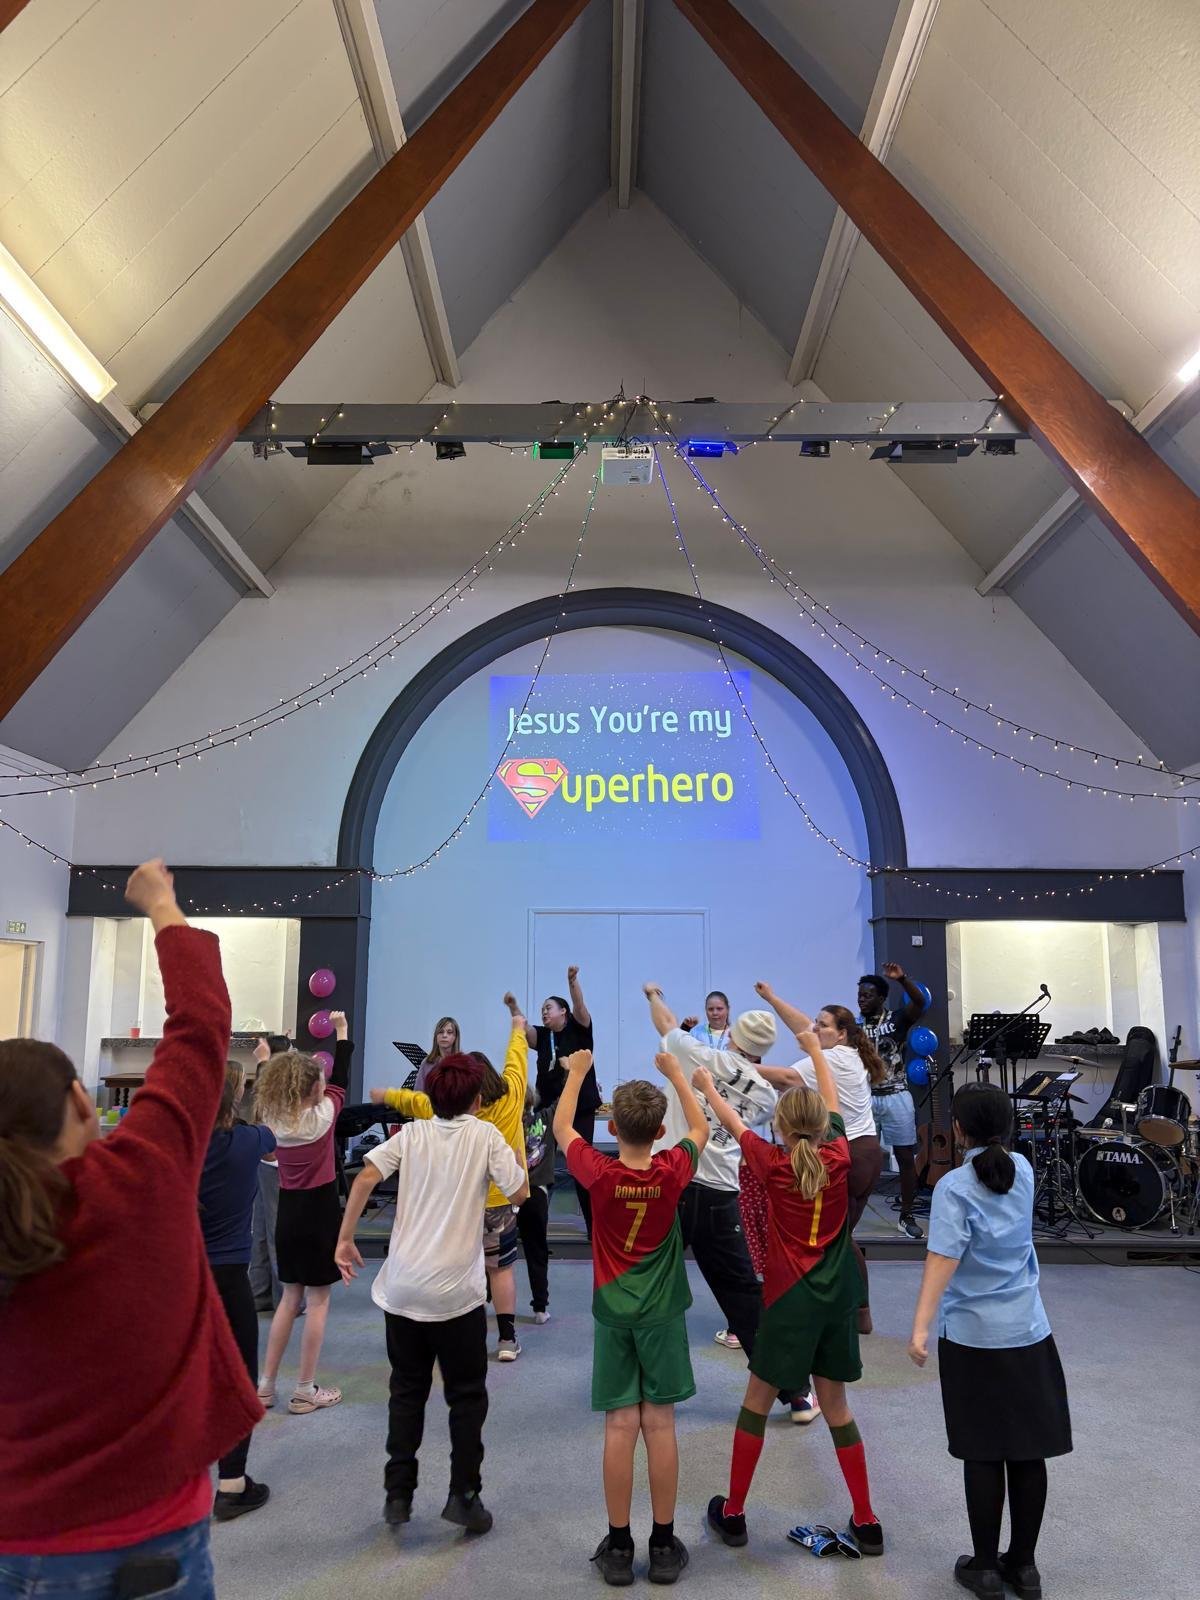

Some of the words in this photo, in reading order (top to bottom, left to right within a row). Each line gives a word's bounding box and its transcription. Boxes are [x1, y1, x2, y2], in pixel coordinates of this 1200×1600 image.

[506, 706, 581, 742] Jesus
[589, 704, 679, 734] You're
[688, 708, 732, 738] my
[1104, 1150, 1140, 1165] TAMA
[614, 1185, 661, 1199] RONALDO
[623, 1201, 648, 1253] 7
